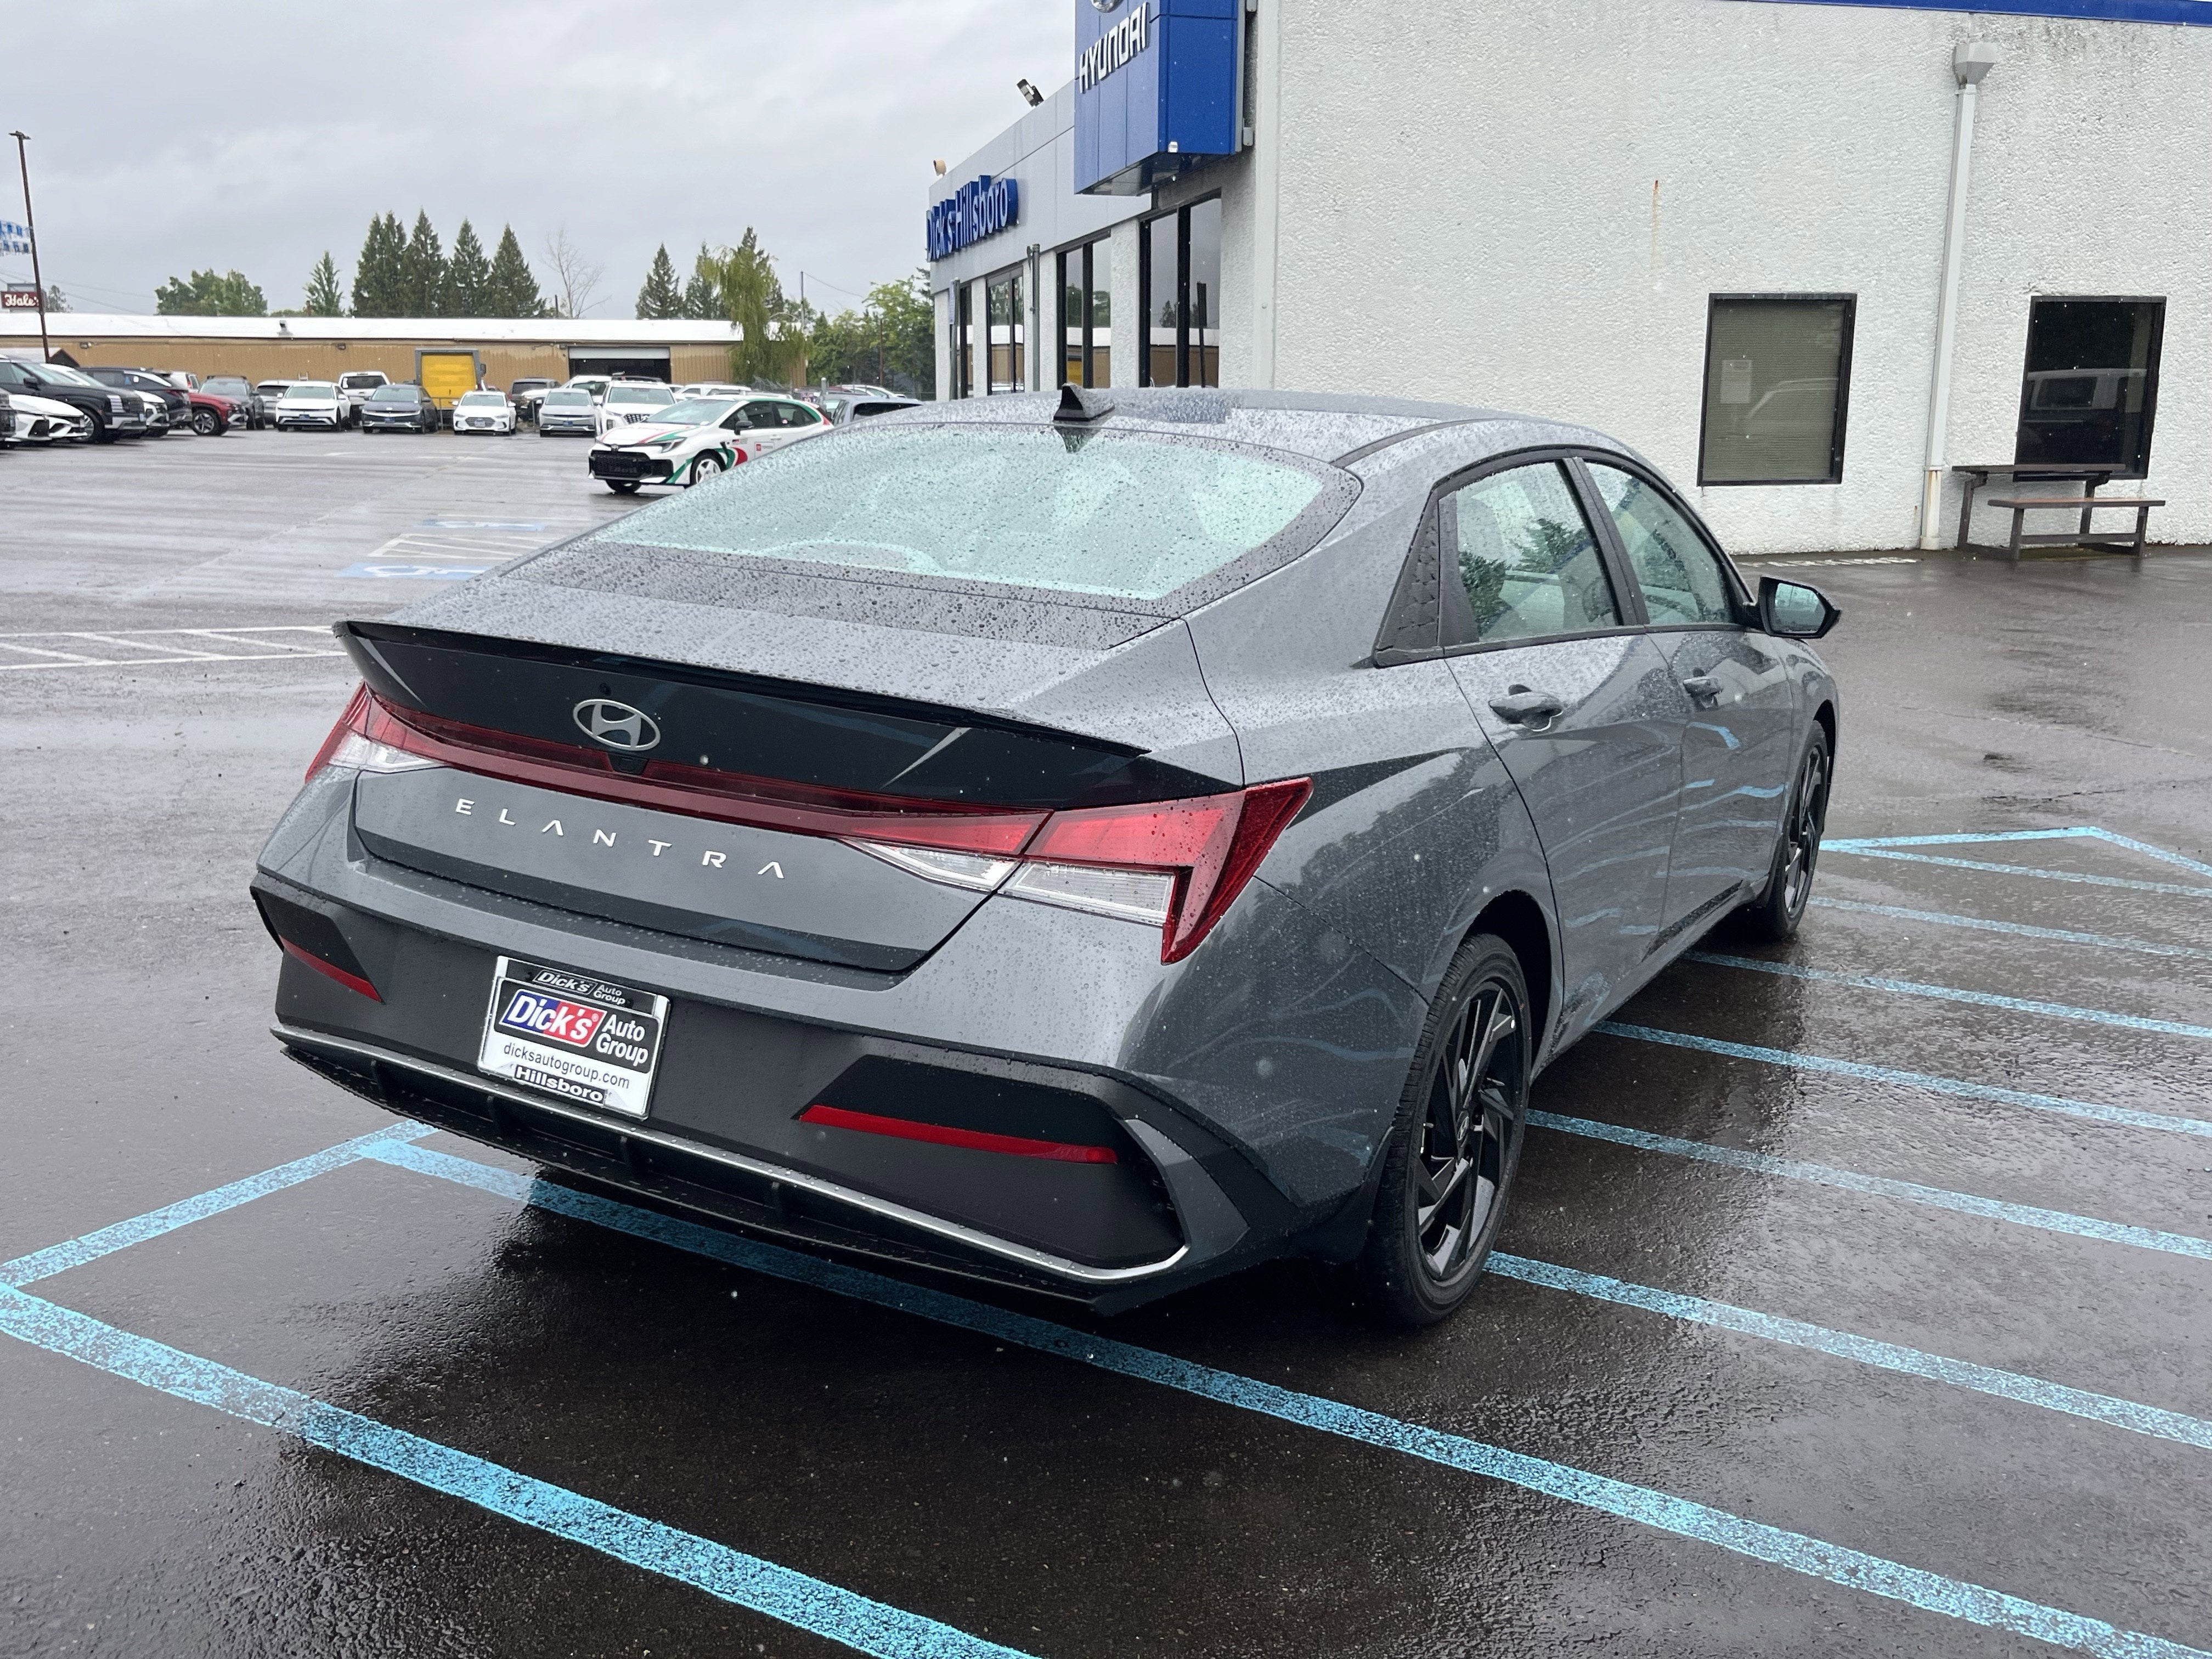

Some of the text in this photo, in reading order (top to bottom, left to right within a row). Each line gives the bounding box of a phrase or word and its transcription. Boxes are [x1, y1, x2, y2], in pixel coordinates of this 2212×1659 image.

[1079, 1, 1149, 94] HYUNDAI
[956, 175, 1011, 249] Hillsboro
[455, 798, 785, 879] ELANTRA
[537, 972, 622, 996] Dick's Auto
[593, 991, 626, 1005] Group
[507, 995, 645, 1042] Dick's Auto
[504, 1042, 630, 1089] dicksautogroup.com
[596, 1034, 648, 1066] Group
[515, 1065, 603, 1103] Hillsboro
